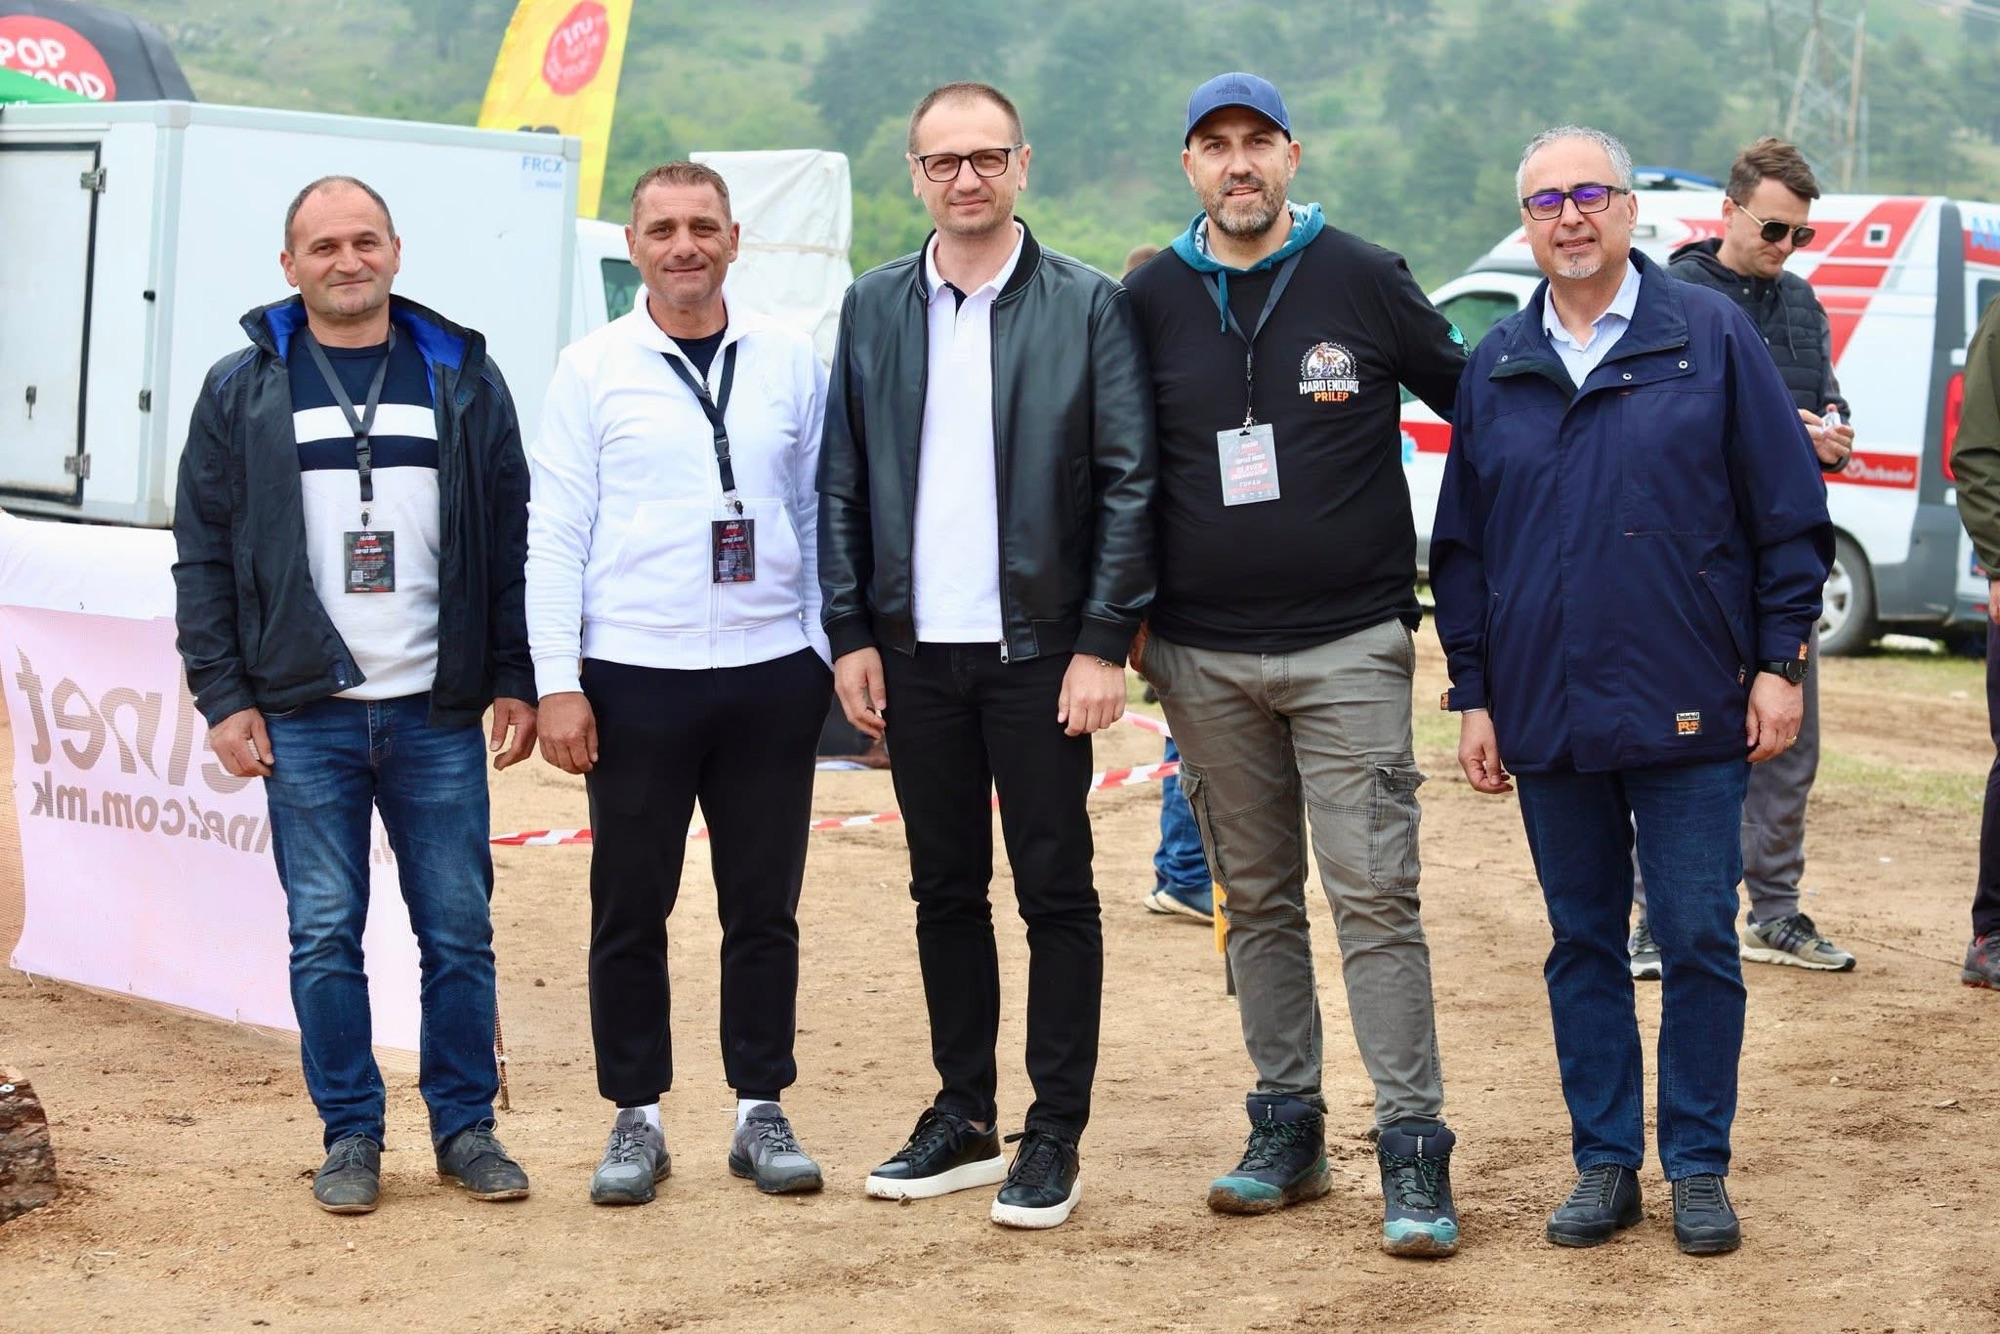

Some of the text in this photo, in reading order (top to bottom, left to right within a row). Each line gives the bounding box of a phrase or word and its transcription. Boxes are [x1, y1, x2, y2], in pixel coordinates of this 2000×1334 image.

[1299, 380, 1360, 394] HARD ENDURO
[1314, 392, 1349, 402] PRILEP
